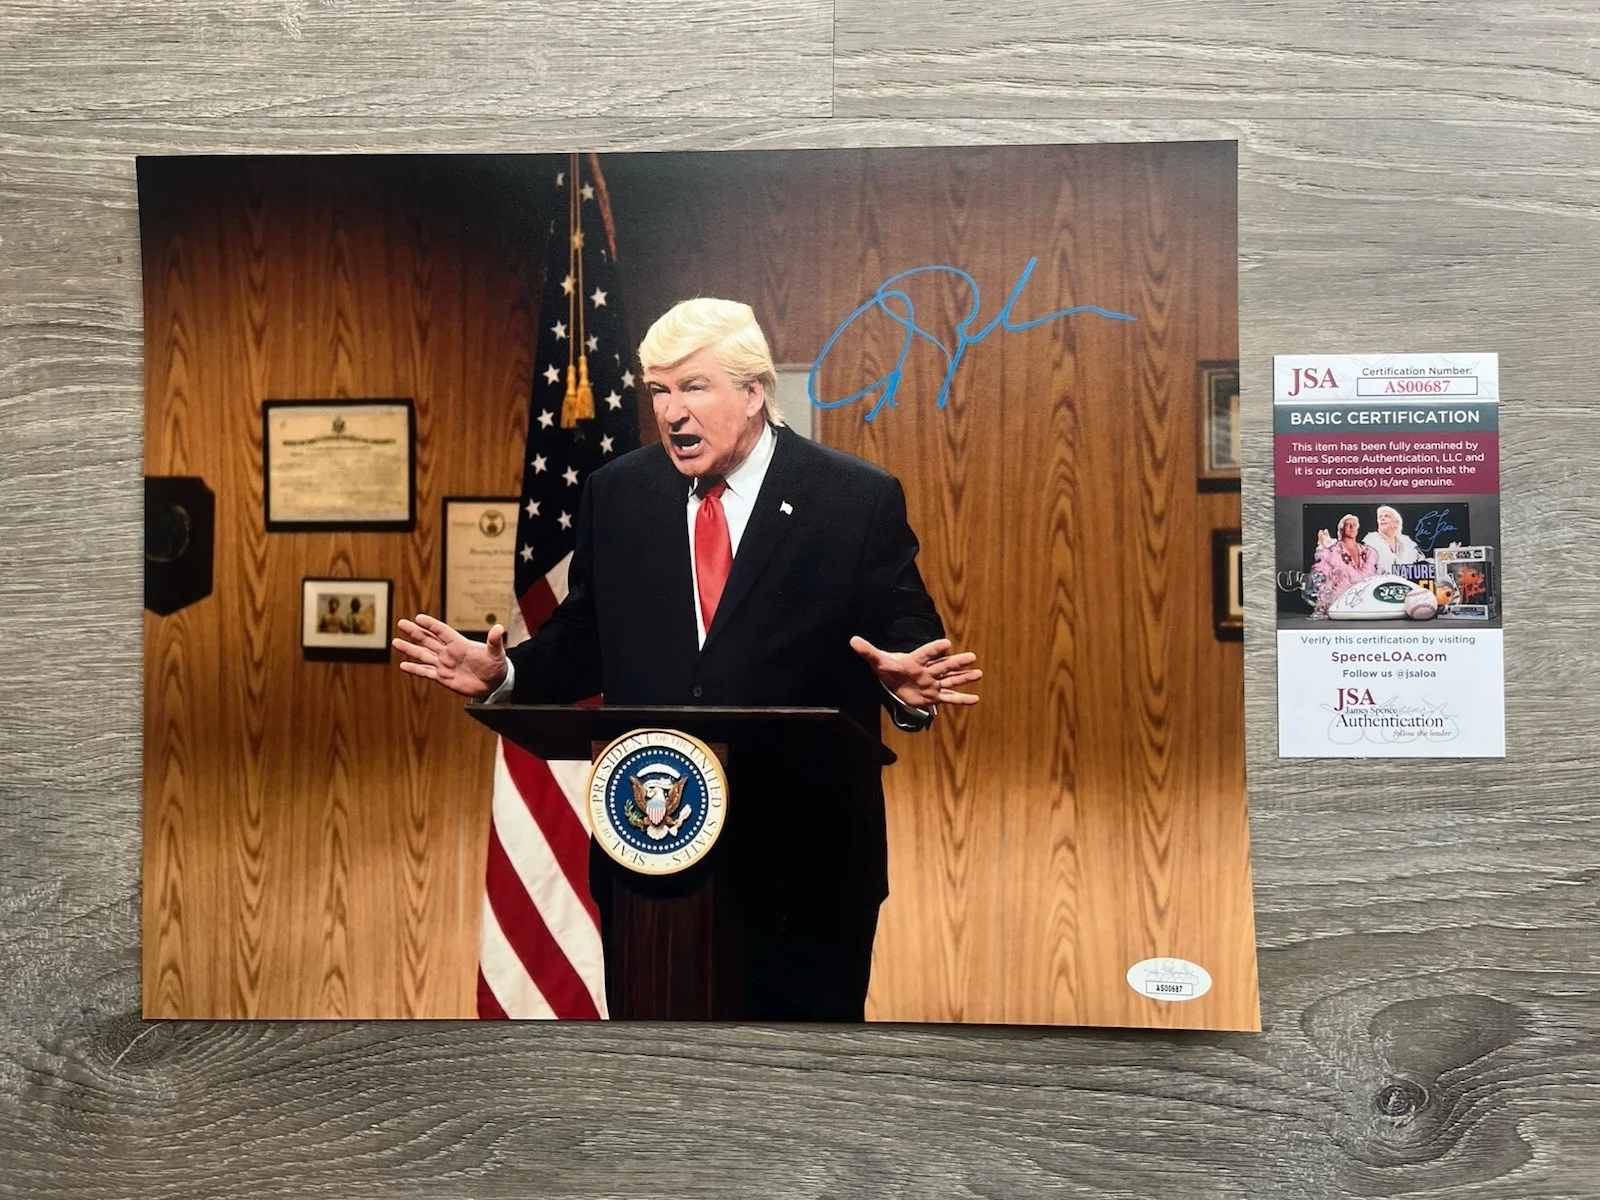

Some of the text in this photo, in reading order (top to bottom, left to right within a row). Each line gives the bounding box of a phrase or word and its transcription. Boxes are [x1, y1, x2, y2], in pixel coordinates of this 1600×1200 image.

[1362, 367, 1472, 376] Certification Number:
[1288, 368, 1339, 396] JSA
[1384, 381, 1450, 393] AS00687
[1290, 410, 1479, 425] BASIC CERTIFICATION
[1292, 442, 1478, 452] This item has been fully examined by
[1286, 453, 1484, 465] James Spence Authentication, LLC and
[1295, 467, 1302, 475] it
[1305, 466, 1312, 475] is
[1336, 466, 1391, 475] considered
[1395, 466, 1433, 476] opinion
[1436, 466, 1456, 474] that
[1459, 465, 1476, 474] the
[1316, 478, 1454, 488] signature(s) is/are genuine.
[1392, 563, 1435, 579] NATURE
[1301, 635, 1475, 645] Verify this certification by visiting
[1332, 651, 1446, 663] SpenceLOA.com
[1396, 669, 1436, 679] @jsaloa
[1334, 688, 1376, 711] JSA
[1370, 706, 1397, 715] Spence
[1336, 714, 1443, 727] Authentication
[1393, 729, 1415, 737] follow
[592, 733, 650, 802] PRESIDENT
[690, 746, 722, 808] UNITED
[672, 818, 717, 865] STATES
[612, 841, 646, 866] SEAL
[1156, 984, 1182, 992] AS00687
